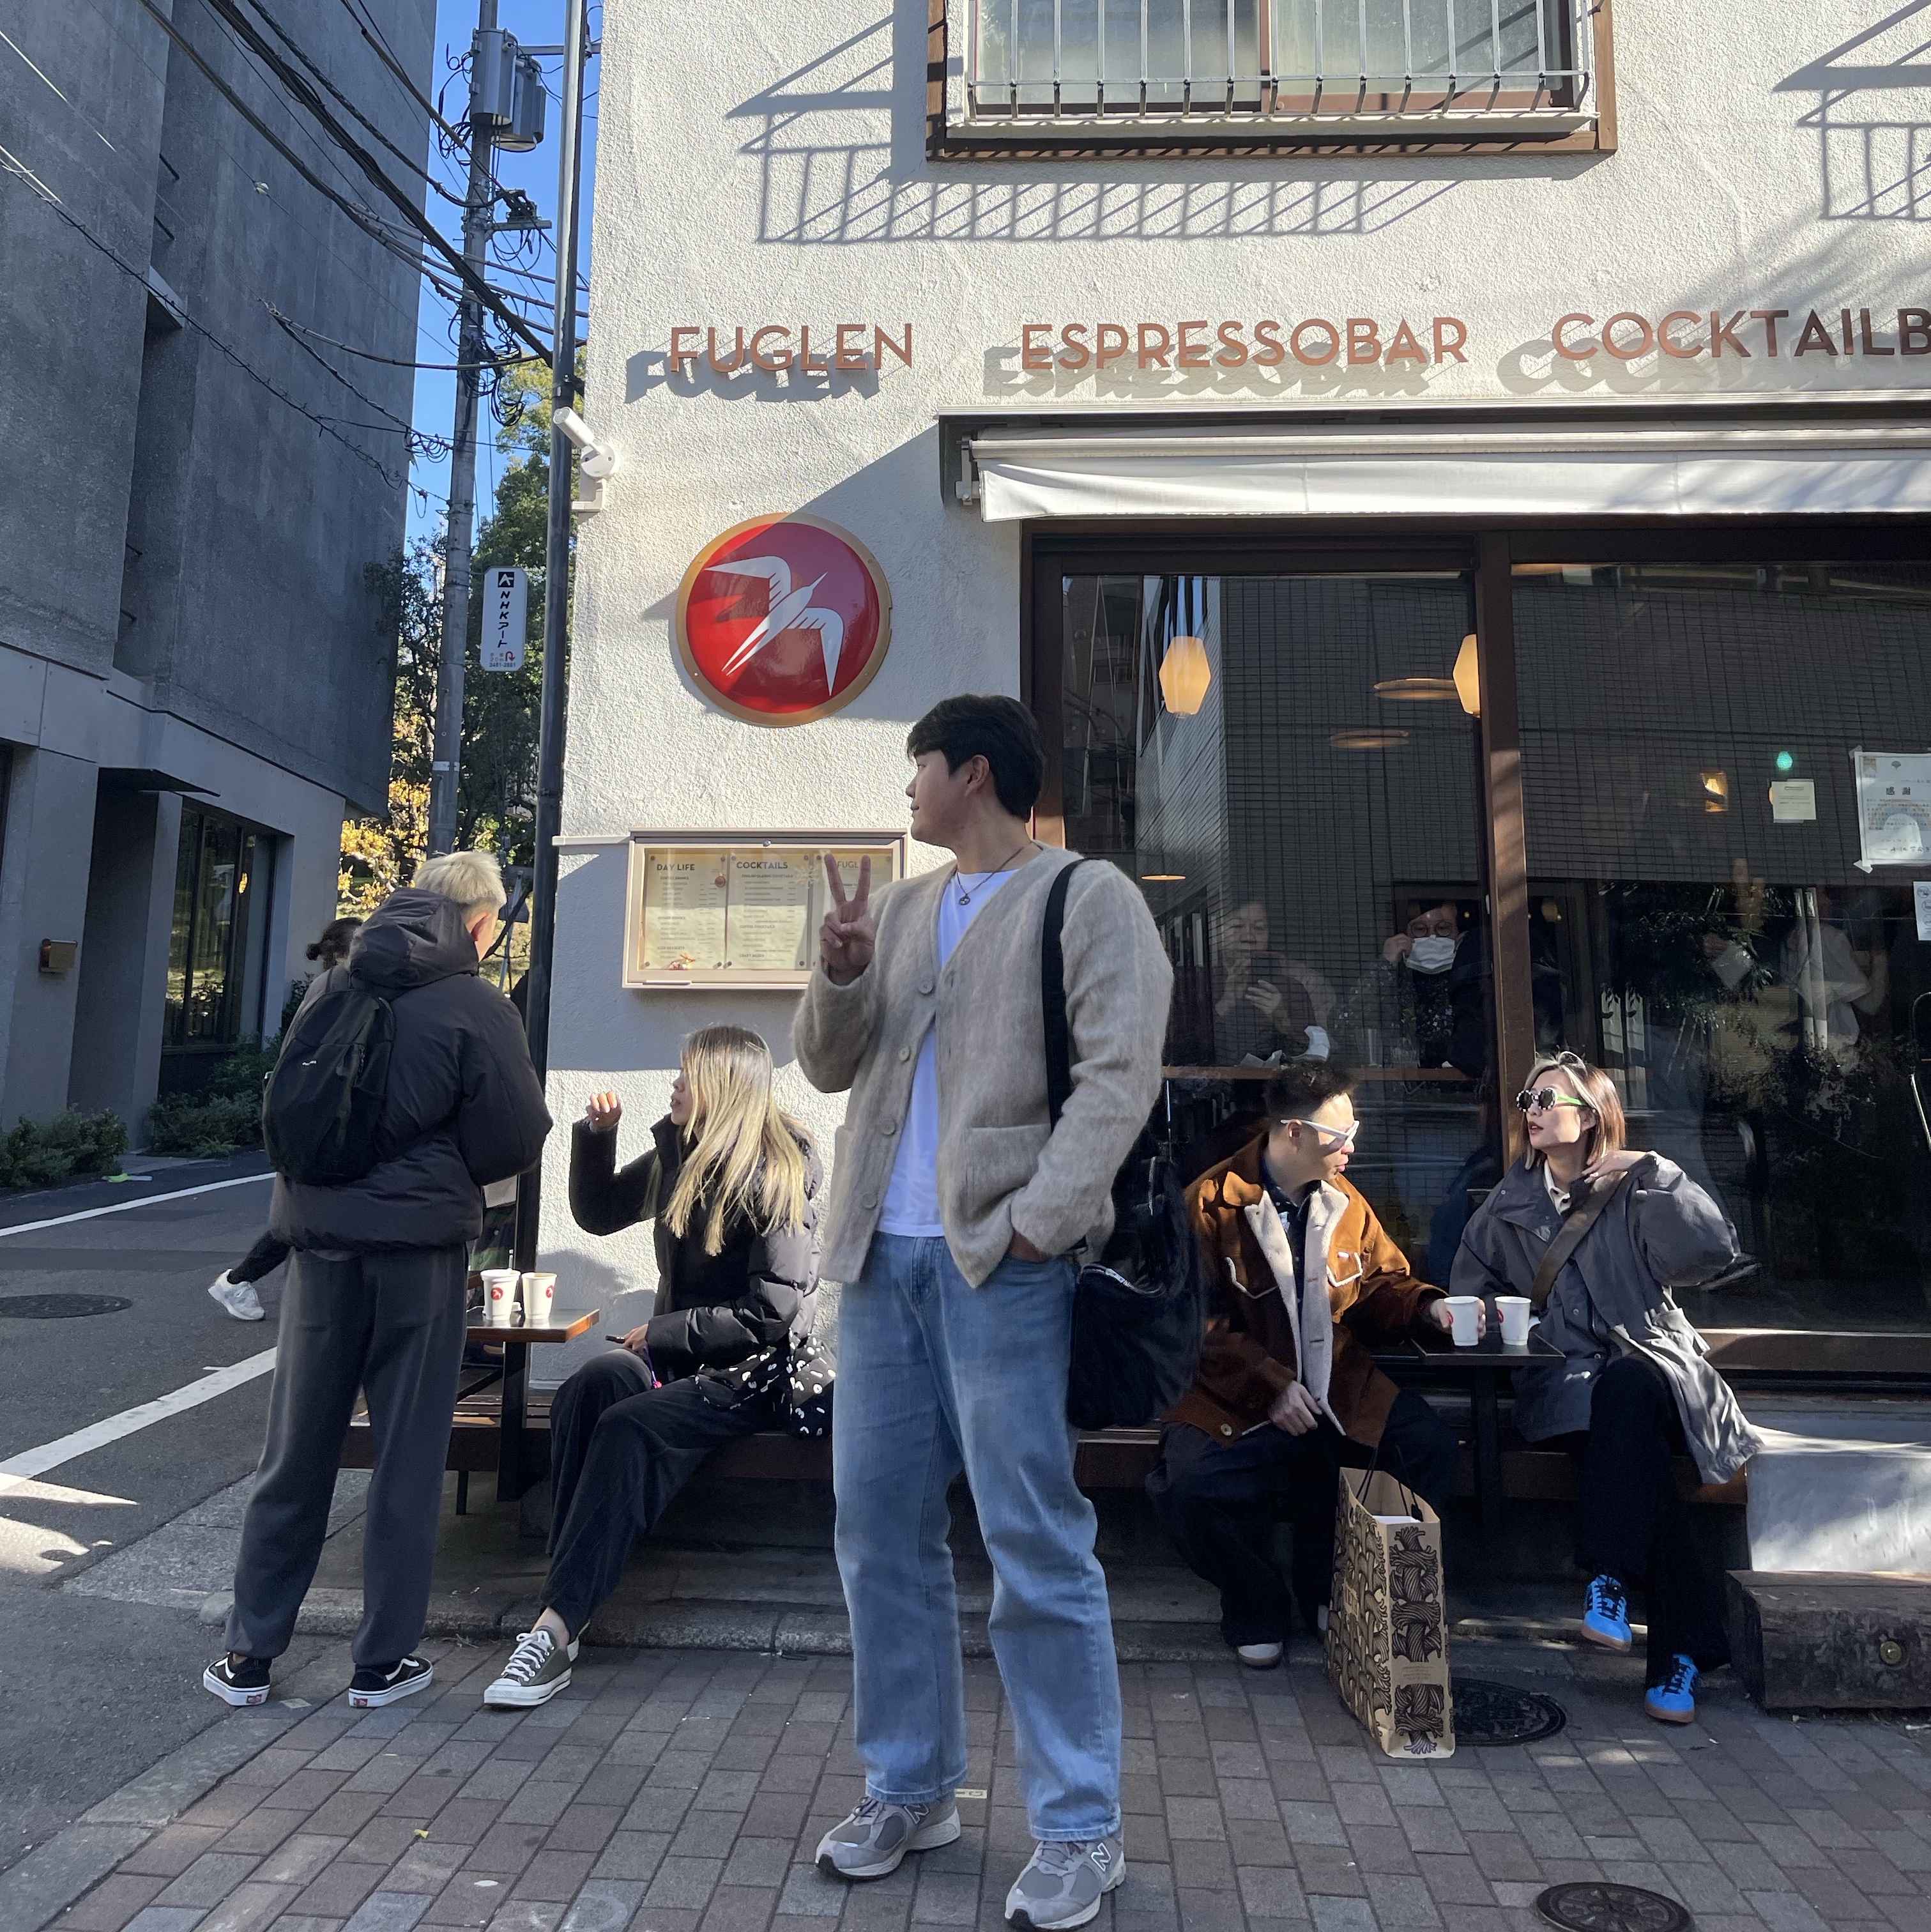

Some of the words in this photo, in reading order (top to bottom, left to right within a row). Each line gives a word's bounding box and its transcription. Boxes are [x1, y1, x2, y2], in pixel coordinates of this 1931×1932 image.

[671, 323, 912, 372] FUGLEN
[1022, 316, 1469, 370] ESPRESSOBAR
[1552, 308, 1931, 360] COCKTAILB
[498, 590, 510, 648] NHKアート
